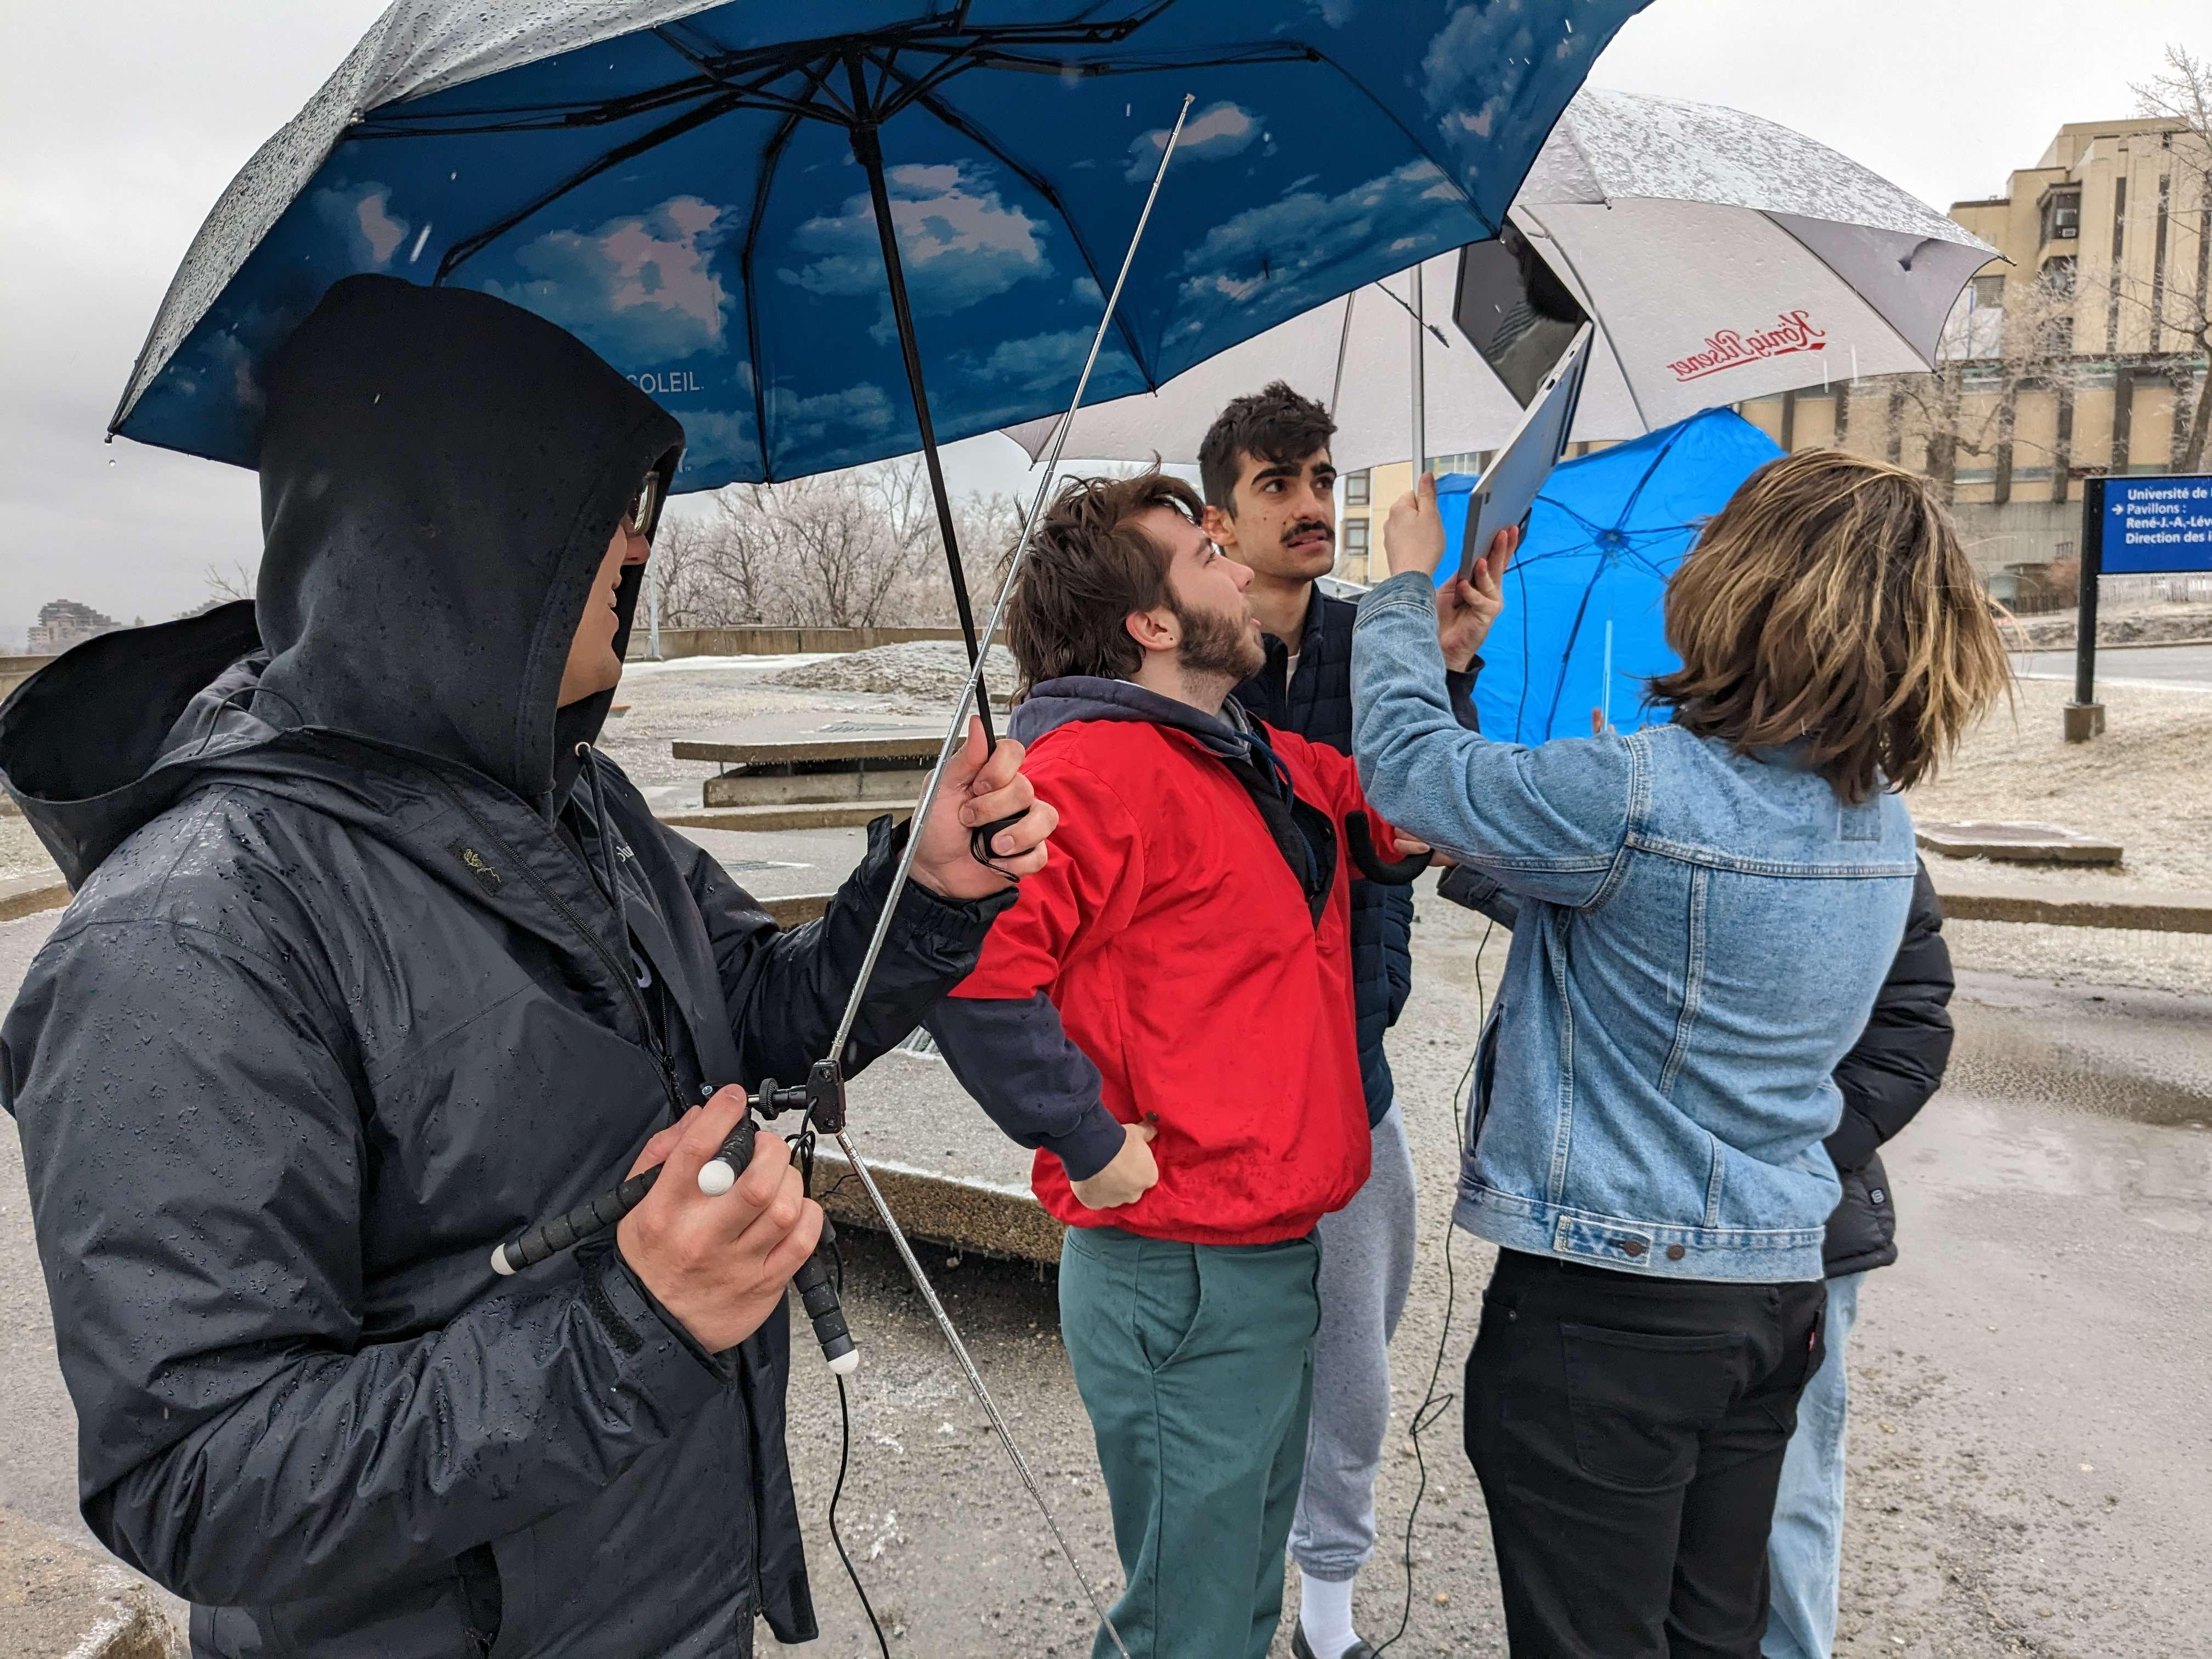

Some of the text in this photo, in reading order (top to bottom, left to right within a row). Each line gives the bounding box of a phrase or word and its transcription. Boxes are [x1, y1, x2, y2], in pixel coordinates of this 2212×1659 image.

[2128, 488, 2189, 500] Université
[2192, 487, 2208, 499] de
[2127, 503, 2180, 515] Pavillons
[2125, 532, 2180, 544] Direction
[2183, 531, 2205, 543] des
